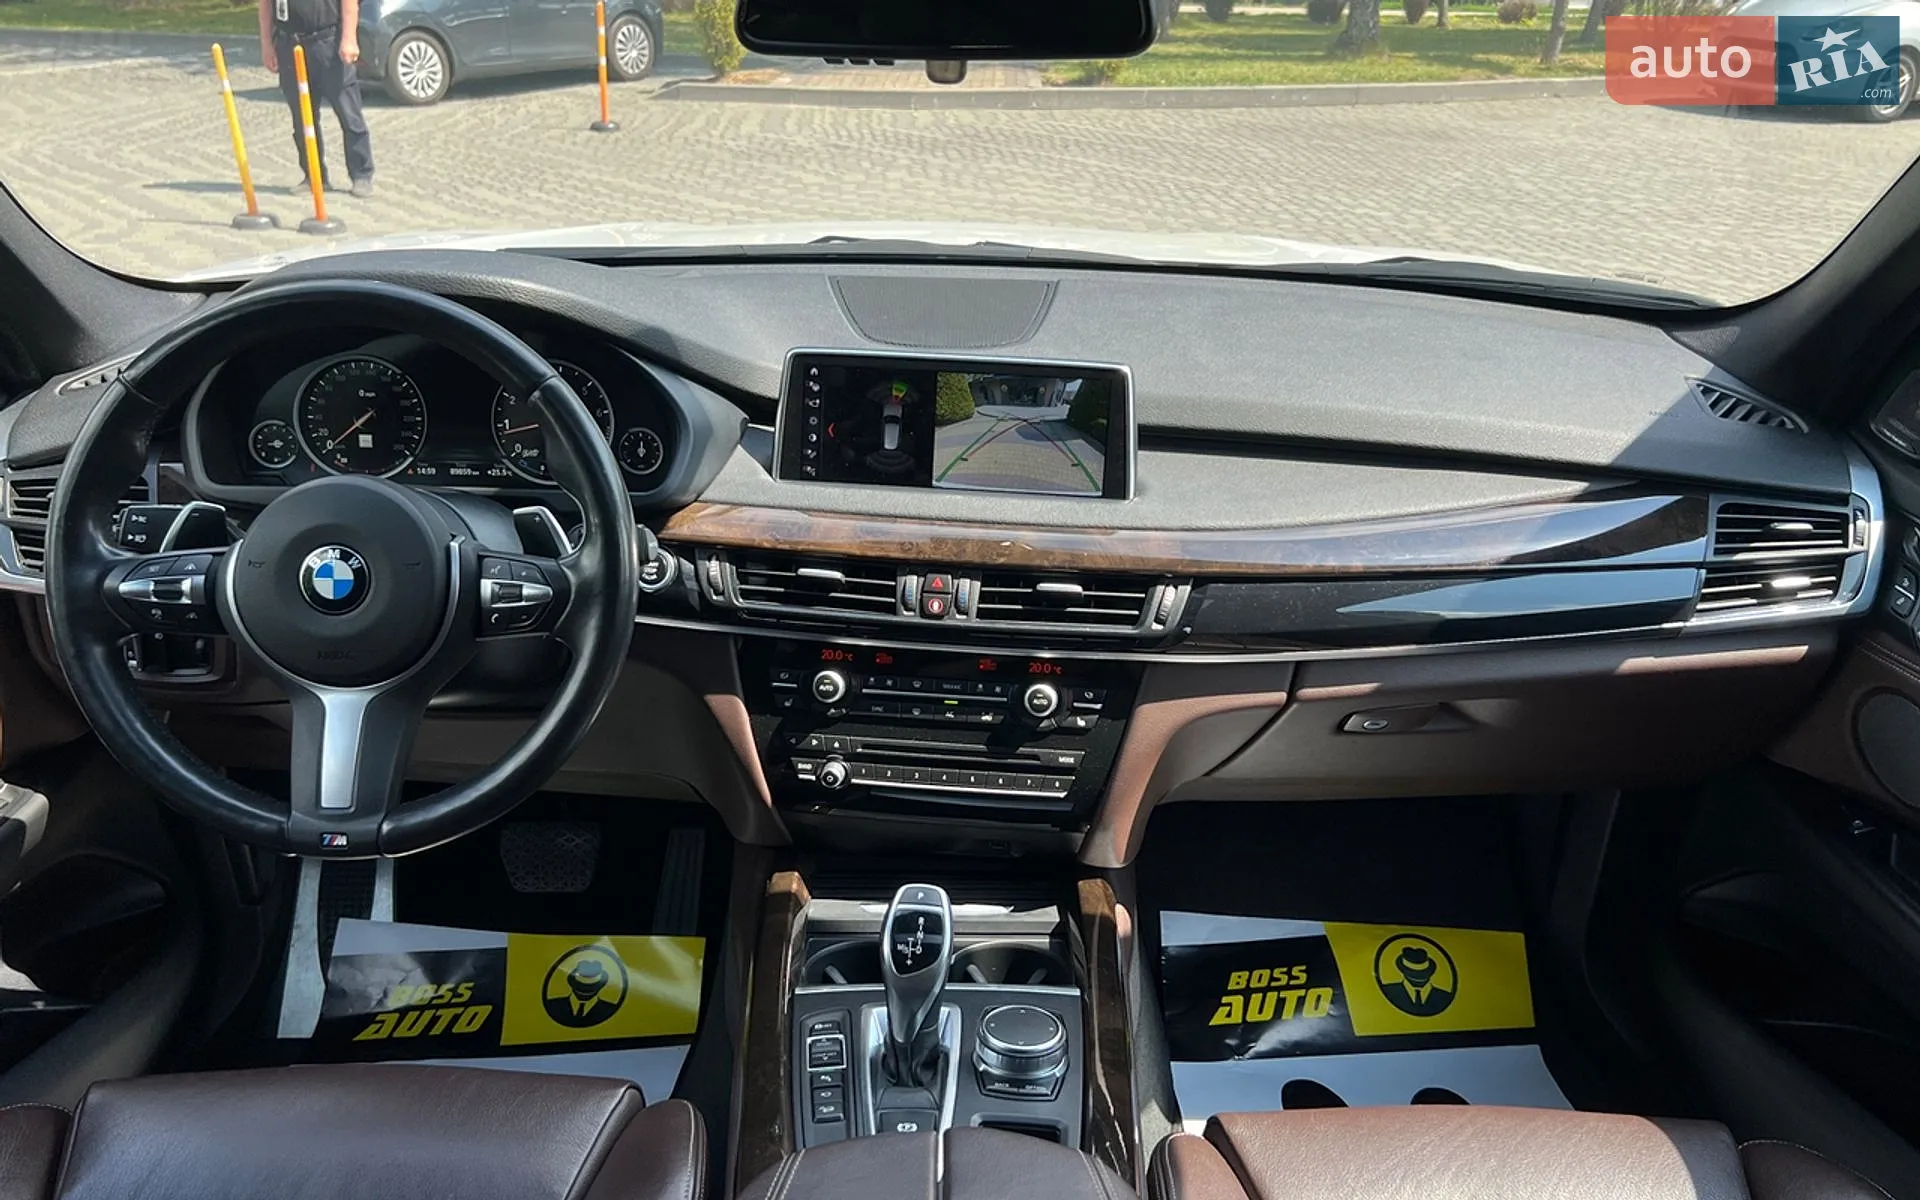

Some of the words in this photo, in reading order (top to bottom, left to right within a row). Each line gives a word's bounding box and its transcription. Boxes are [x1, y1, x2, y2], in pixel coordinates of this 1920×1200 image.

[508, 396, 517, 405] 2
[504, 418, 510, 430] 1
[326, 439, 334, 450] 0
[514, 443, 522, 453] 0
[307, 548, 363, 571] BMW
[821, 649, 843, 661] 20.0
[917, 891, 925, 900] P
[1227, 965, 1307, 990] BOSS
[390, 982, 475, 1005] BOSS
[1209, 987, 1334, 1026] AUTO
[352, 1005, 493, 1041] AUTO
